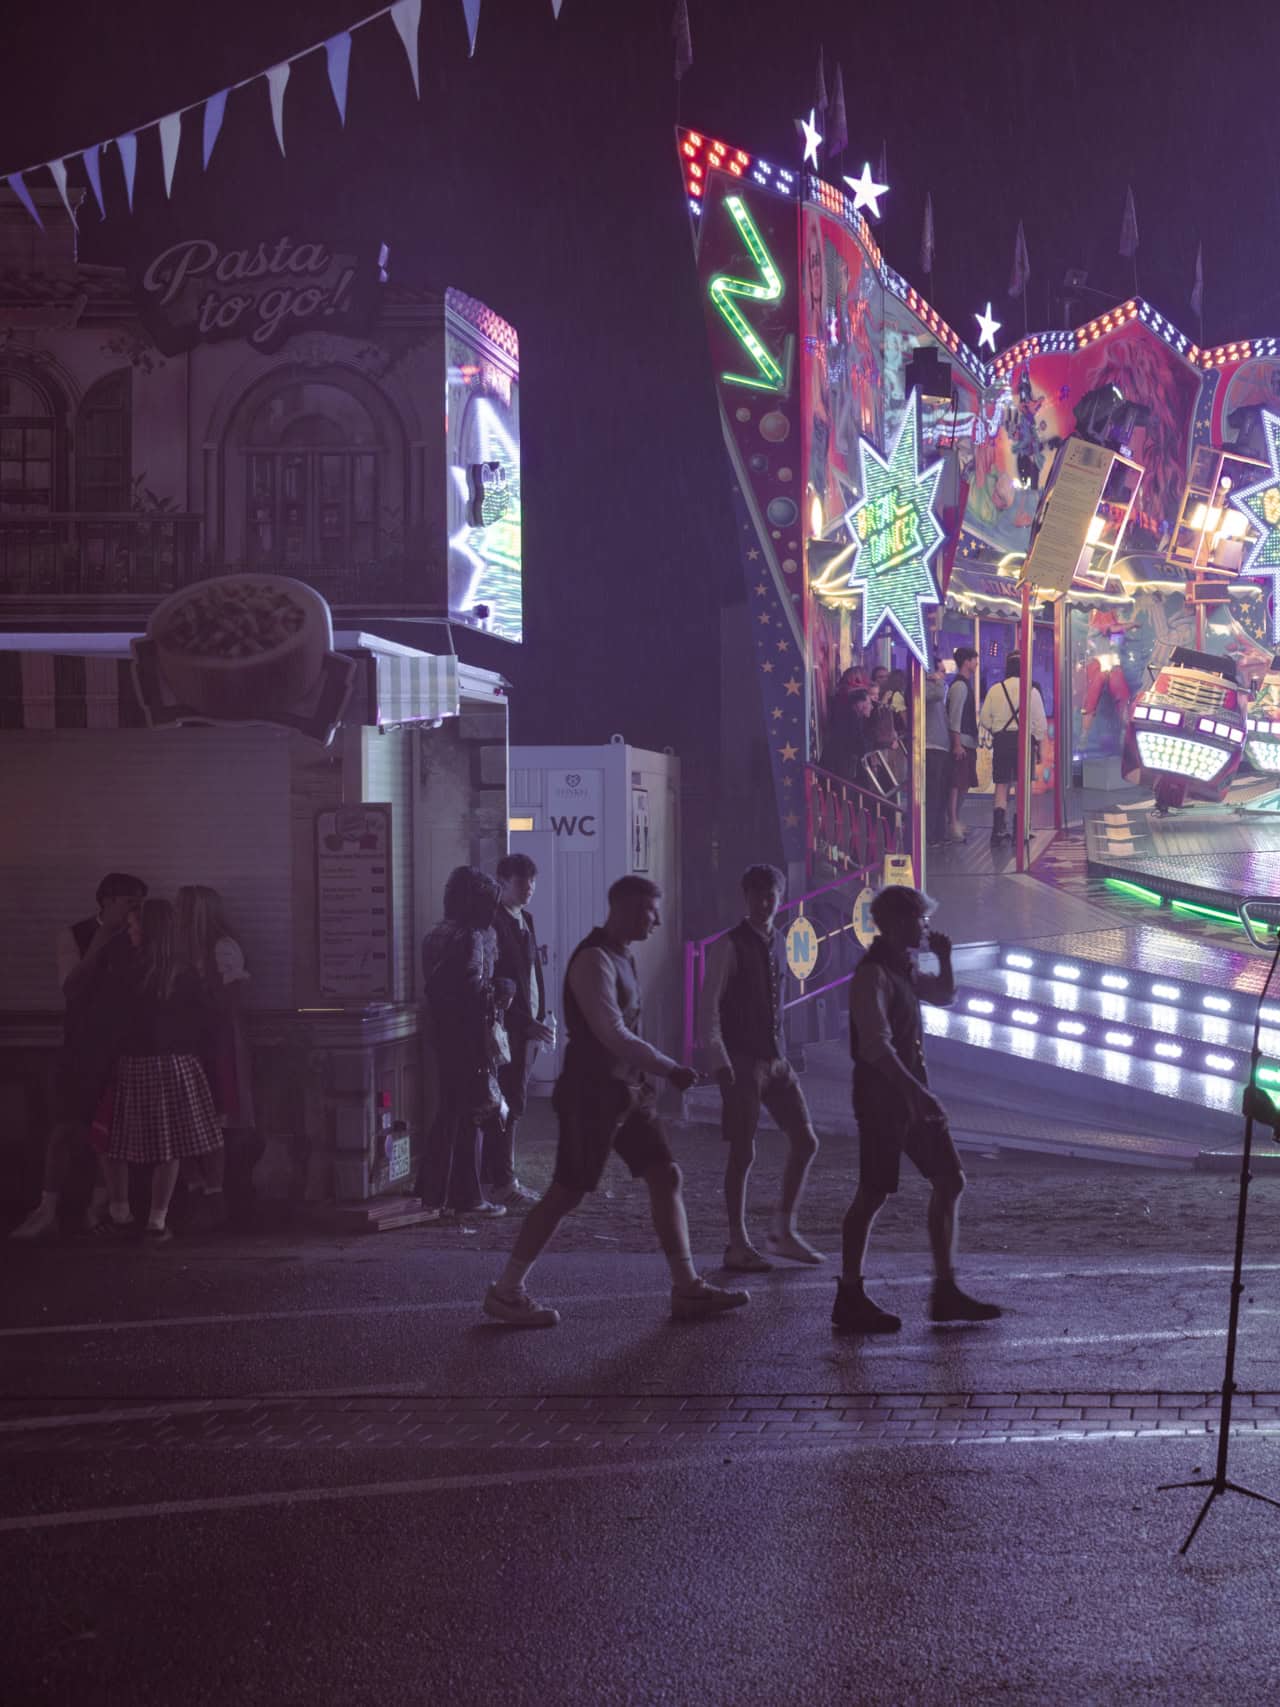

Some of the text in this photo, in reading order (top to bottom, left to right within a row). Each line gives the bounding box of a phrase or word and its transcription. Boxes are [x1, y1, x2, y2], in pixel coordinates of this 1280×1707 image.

[143, 236, 329, 306] Pasta
[200, 269, 354, 343] to go!
[550, 816, 595, 836] WC
